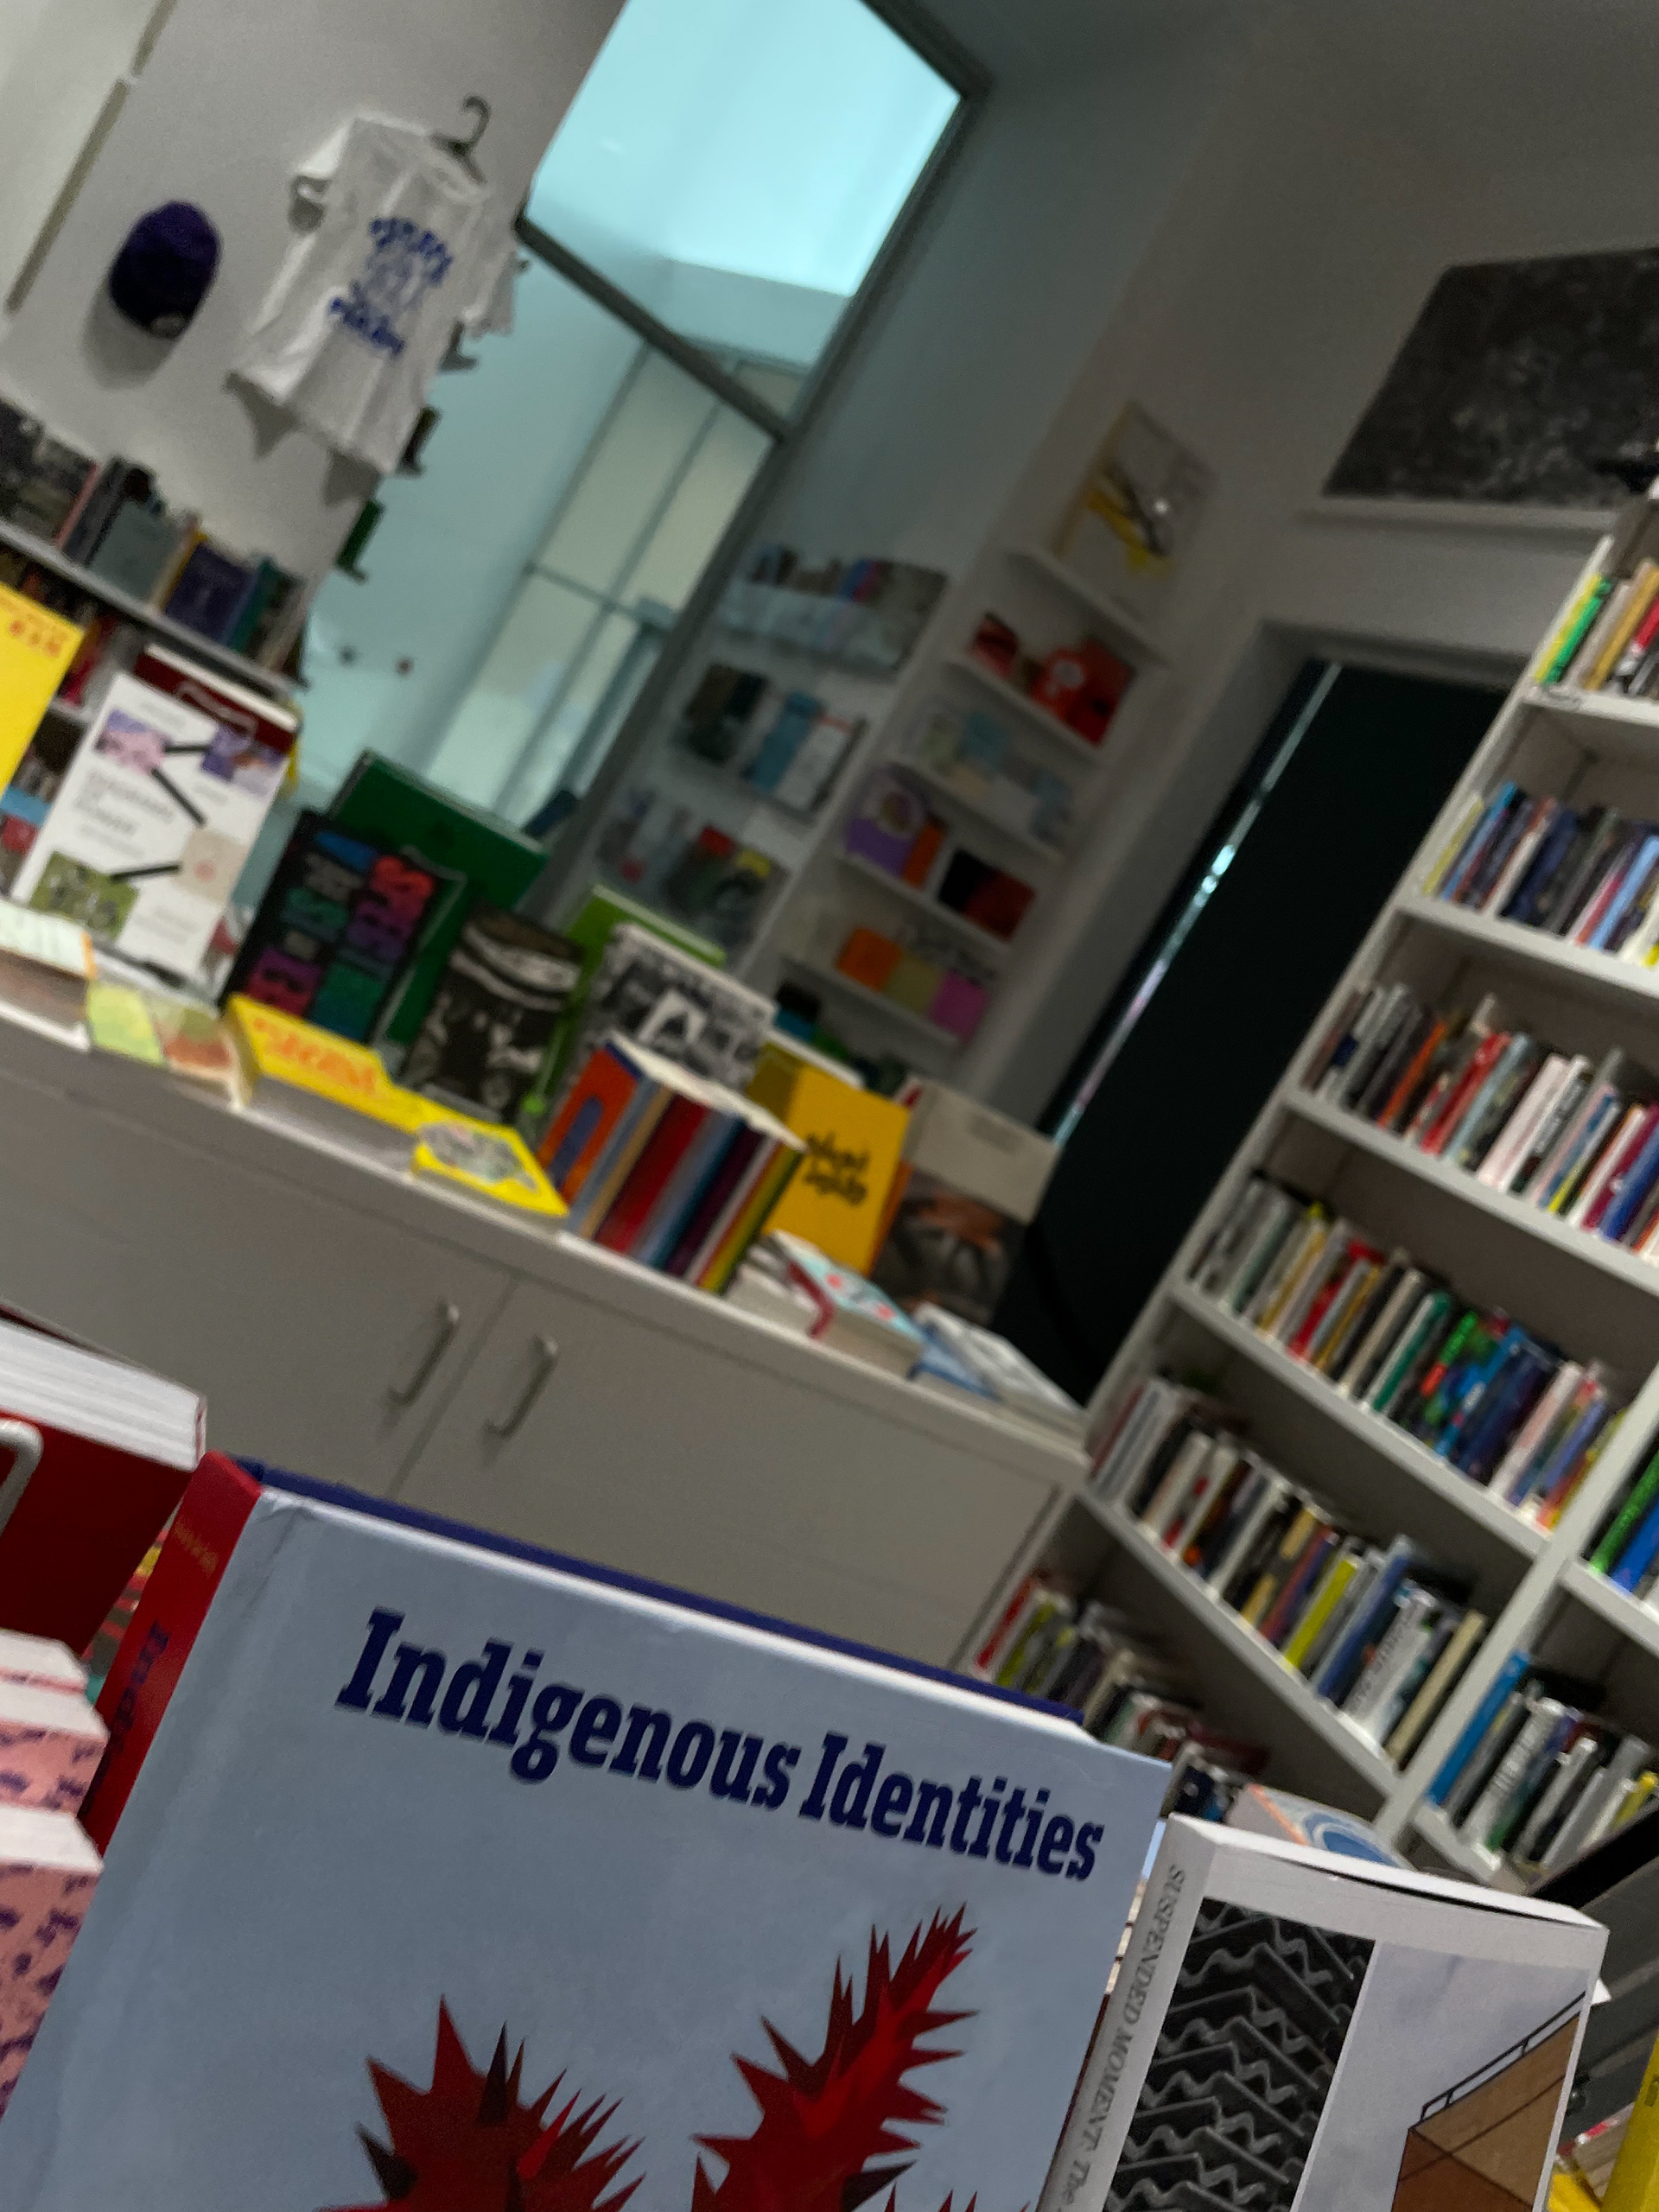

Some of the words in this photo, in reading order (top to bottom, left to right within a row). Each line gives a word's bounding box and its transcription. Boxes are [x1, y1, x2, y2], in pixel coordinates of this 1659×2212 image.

[334, 1606, 802, 1811] Indigenous
[798, 1731, 1106, 1882] Identities
[1125, 1864, 1186, 2024] SUSPENDED
[1061, 2159, 1092, 2206] The
